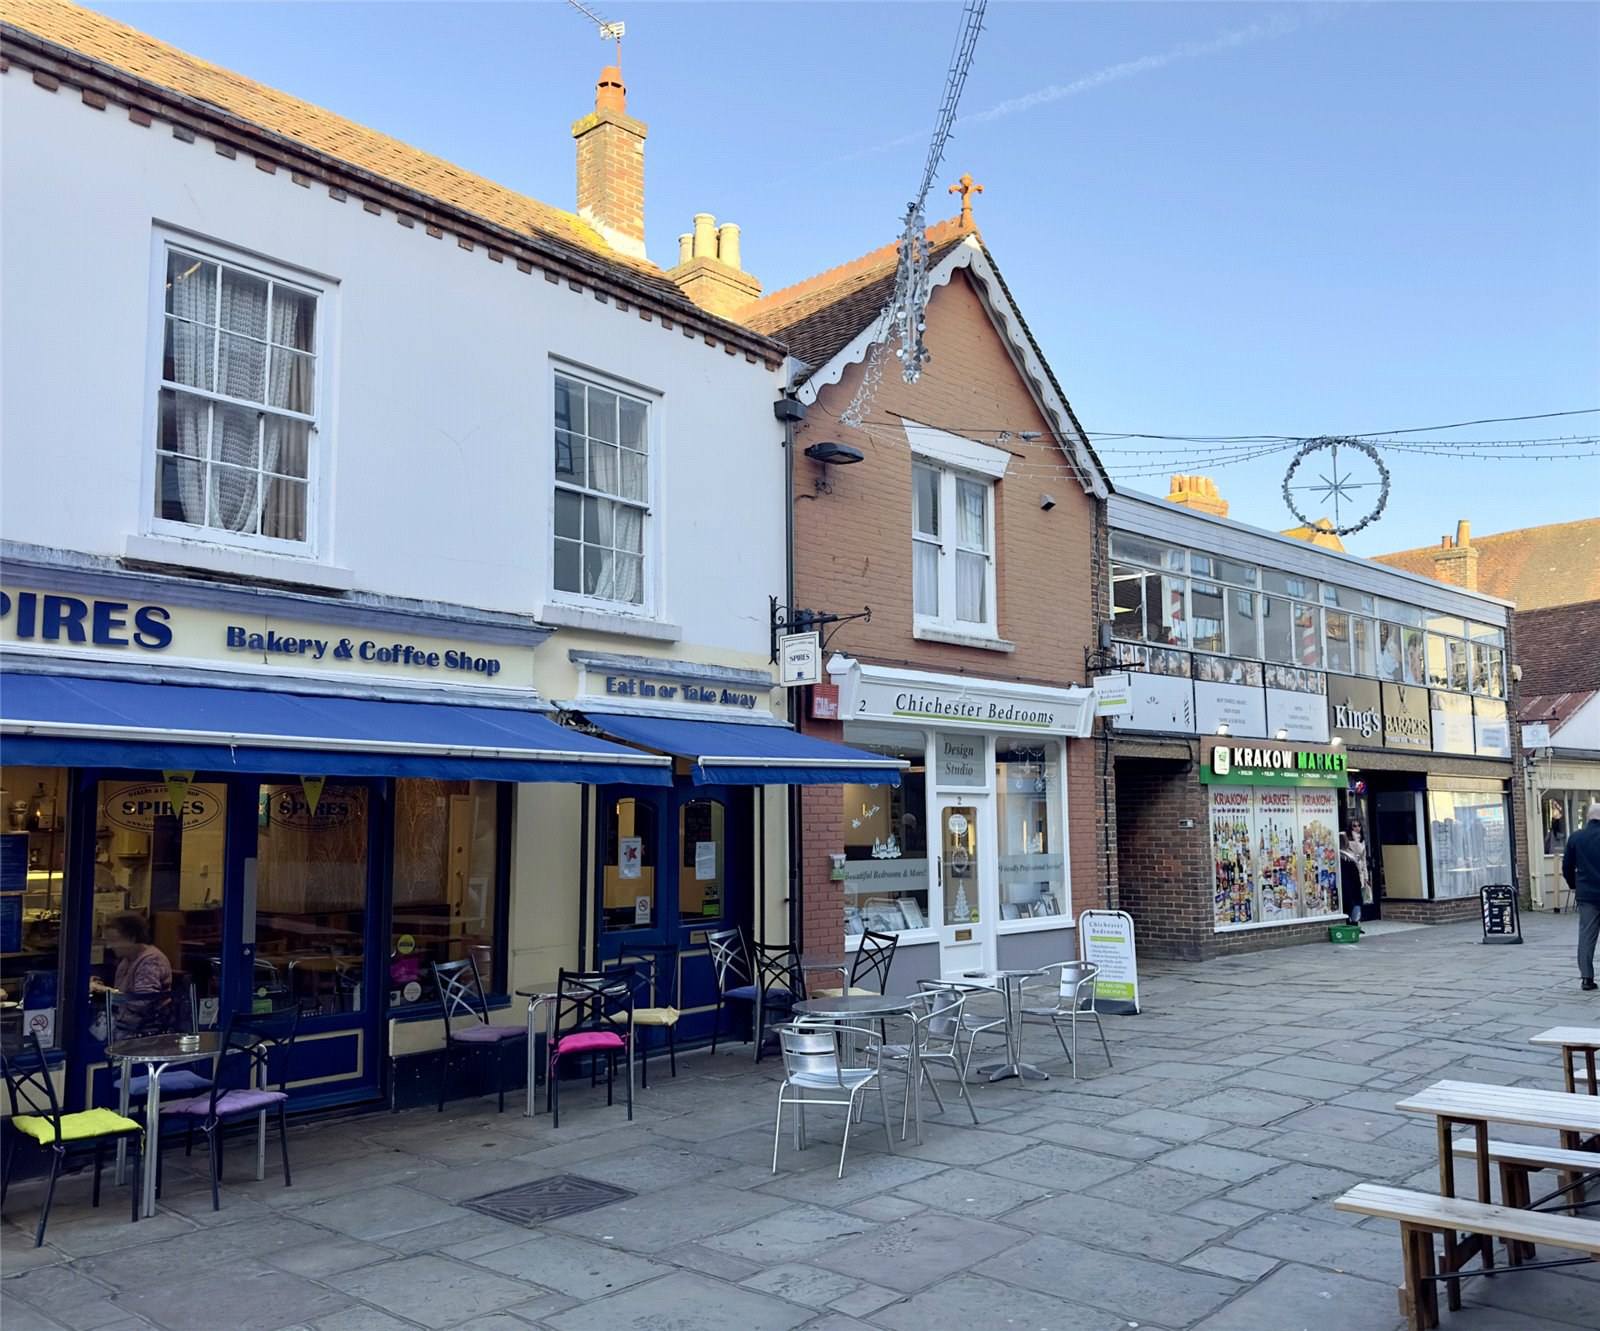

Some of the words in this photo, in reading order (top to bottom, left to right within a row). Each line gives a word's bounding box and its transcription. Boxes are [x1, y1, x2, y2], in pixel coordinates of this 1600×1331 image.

[226, 626, 328, 660] Bakery
[333, 638, 354, 658] &
[359, 641, 440, 667] Coffee
[444, 650, 500, 676] Shop
[789, 653, 810, 663] SPIRES
[606, 676, 636, 696] Eat
[639, 680, 656, 697] In
[659, 685, 677, 698] or
[681, 683, 717, 703] Take
[719, 688, 758, 709] Away
[858, 699, 866, 712] 2
[895, 693, 982, 717] Chichester
[988, 703, 1054, 724] Bedrooms
[1334, 704, 1380, 738] King's
[944, 741, 974, 757] Design
[1234, 747, 1292, 769] KRAKOW
[1297, 751, 1348, 771] MARKET
[944, 762, 974, 776] Studio
[957, 796, 962, 805] 2
[1213, 793, 1249, 806] KRAKOW
[1261, 793, 1290, 806] MARKET
[1302, 794, 1331, 806] KRAKOW
[873, 869, 901, 879] Bedrooms
[903, 869, 908, 877] &
[1089, 921, 1123, 929] Chichester
